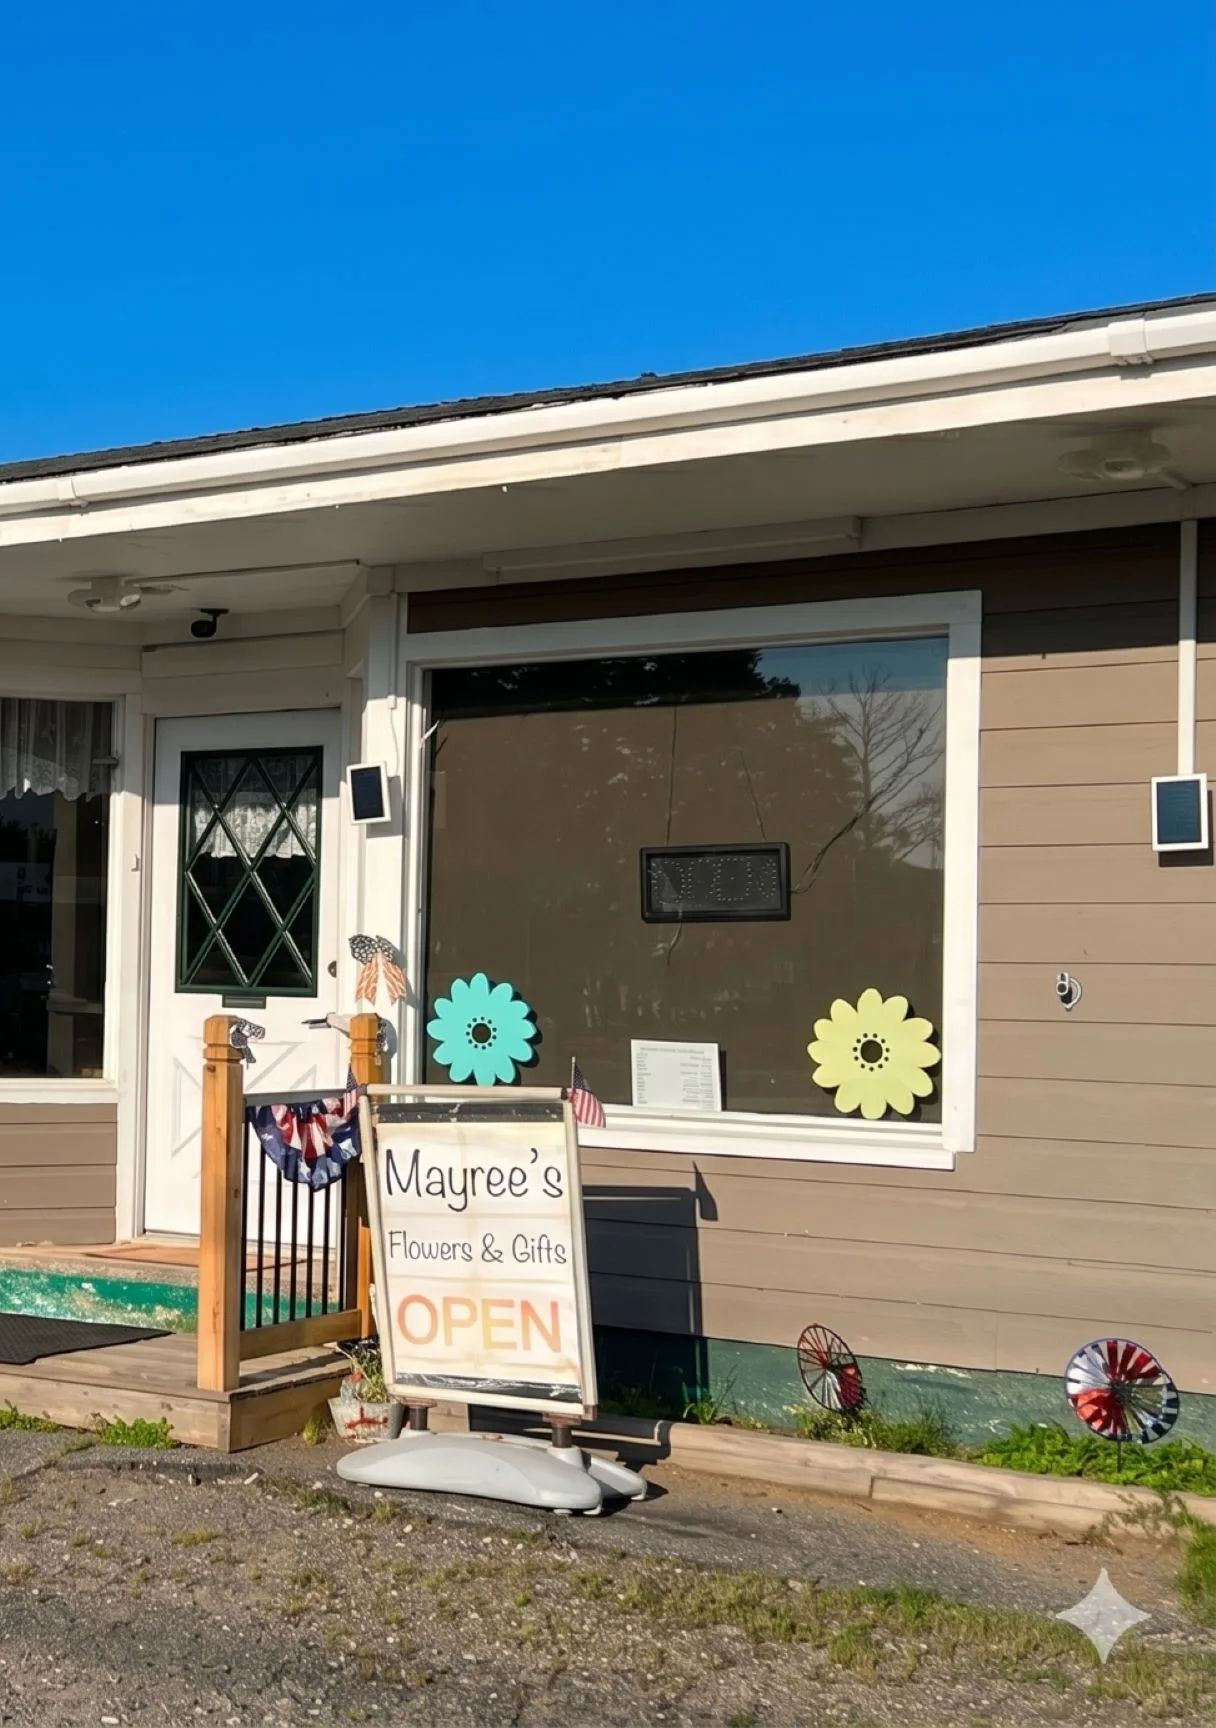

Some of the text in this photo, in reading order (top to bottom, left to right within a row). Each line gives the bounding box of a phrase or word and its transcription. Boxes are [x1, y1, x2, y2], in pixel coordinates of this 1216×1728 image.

[385, 1148, 563, 1212] Mayree's
[388, 1230, 567, 1264] Flowers & Gifts
[397, 1294, 562, 1353] OPEN
